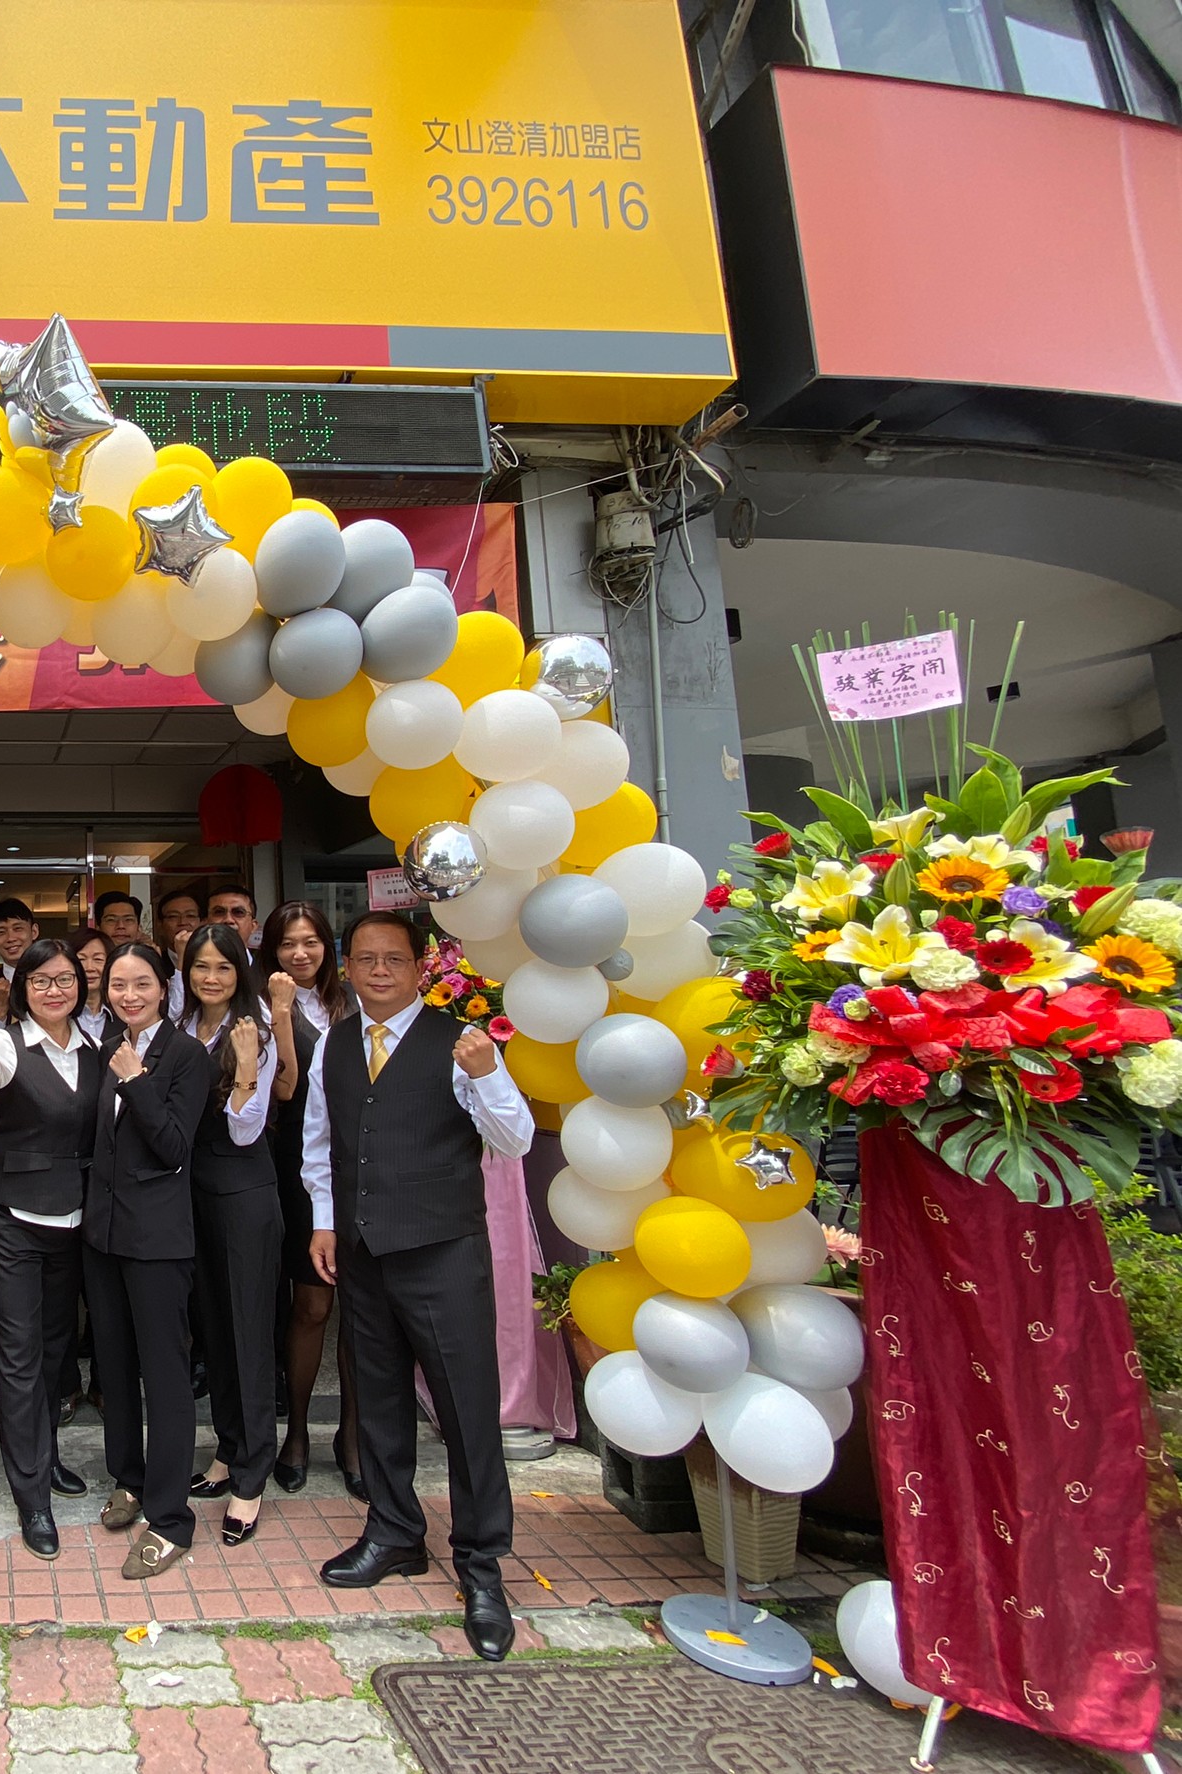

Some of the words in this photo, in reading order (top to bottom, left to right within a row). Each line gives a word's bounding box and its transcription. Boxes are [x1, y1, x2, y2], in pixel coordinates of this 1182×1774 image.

[422, 117, 642, 161] 文山澄清加盟店
[427, 174, 649, 231] 3926116
[833, 657, 946, 692] 駿業宏開
